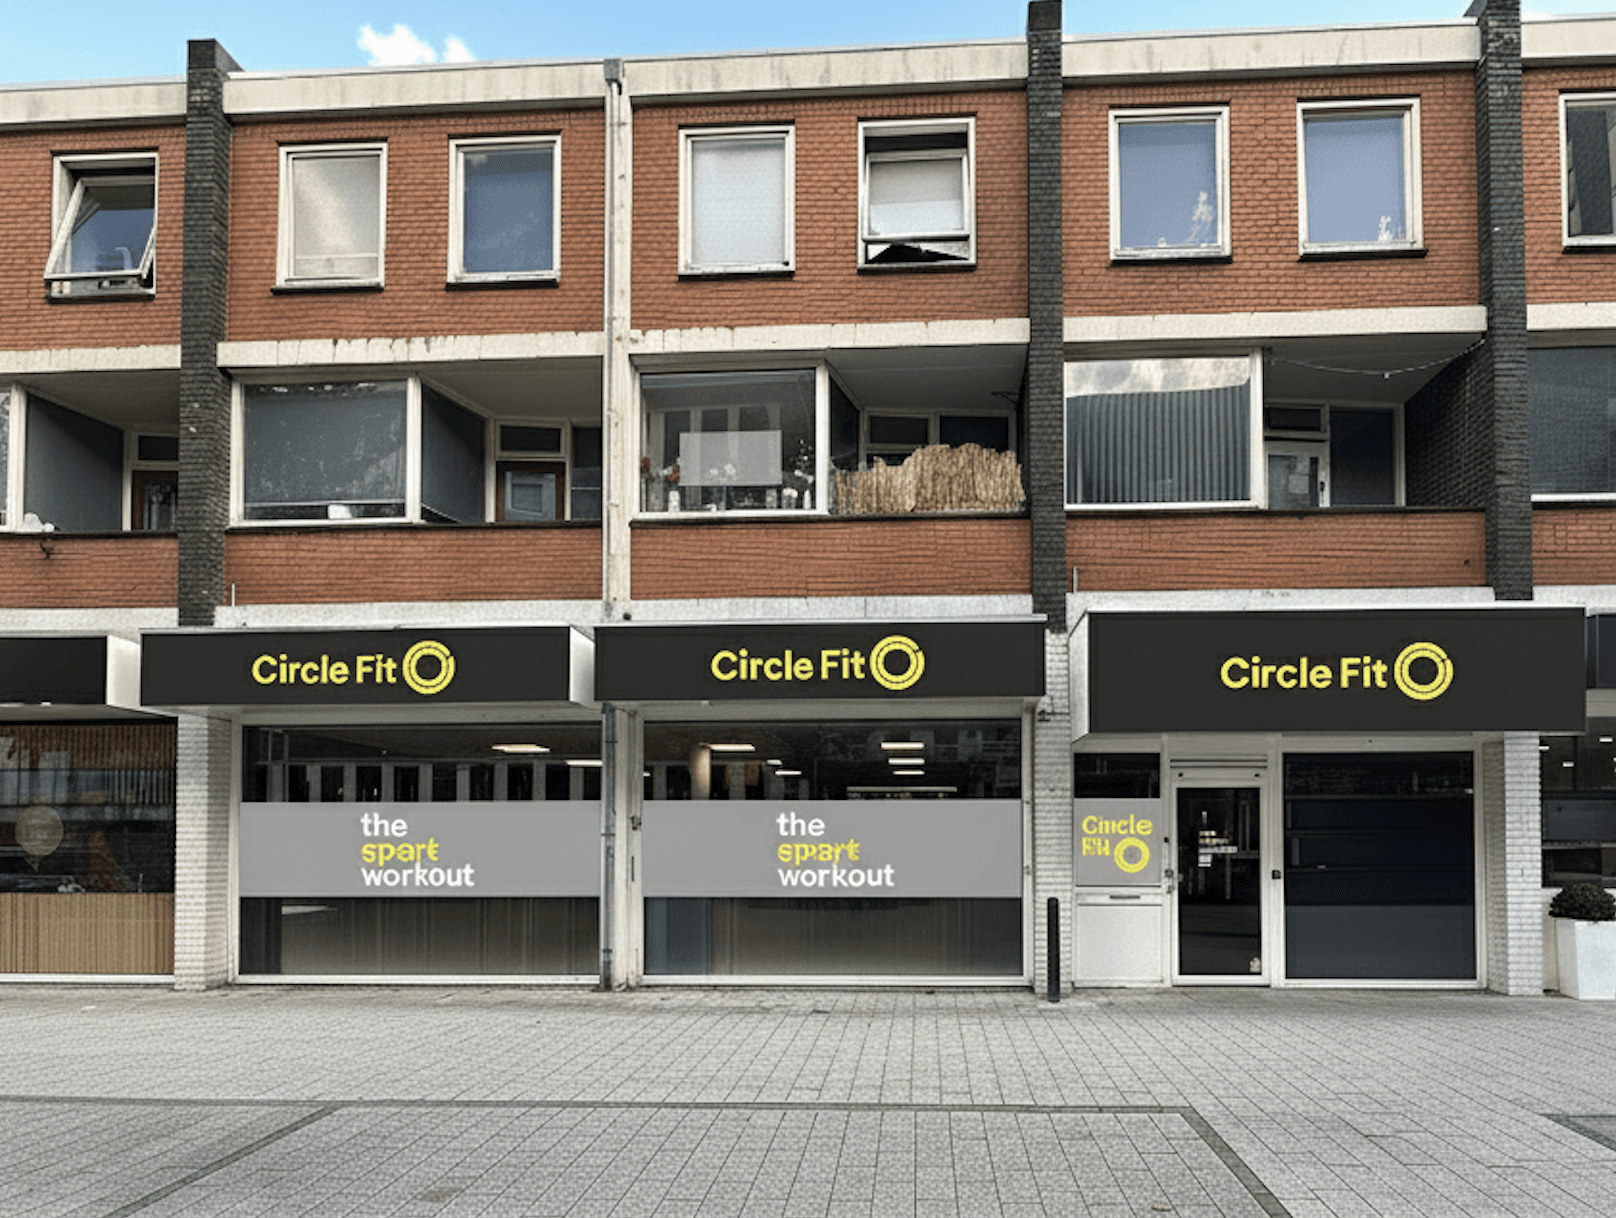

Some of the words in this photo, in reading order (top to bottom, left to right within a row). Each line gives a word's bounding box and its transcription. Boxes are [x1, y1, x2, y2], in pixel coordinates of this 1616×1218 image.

[251, 653, 350, 685] Circle
[356, 653, 398, 684] Fit
[711, 648, 814, 681] Circle
[820, 647, 866, 680] Fit
[1220, 655, 1333, 689] Circle
[1340, 655, 1388, 689] Fit
[360, 812, 409, 838] the
[775, 811, 826, 837] the
[360, 861, 475, 887] workout
[777, 862, 895, 888] workout
